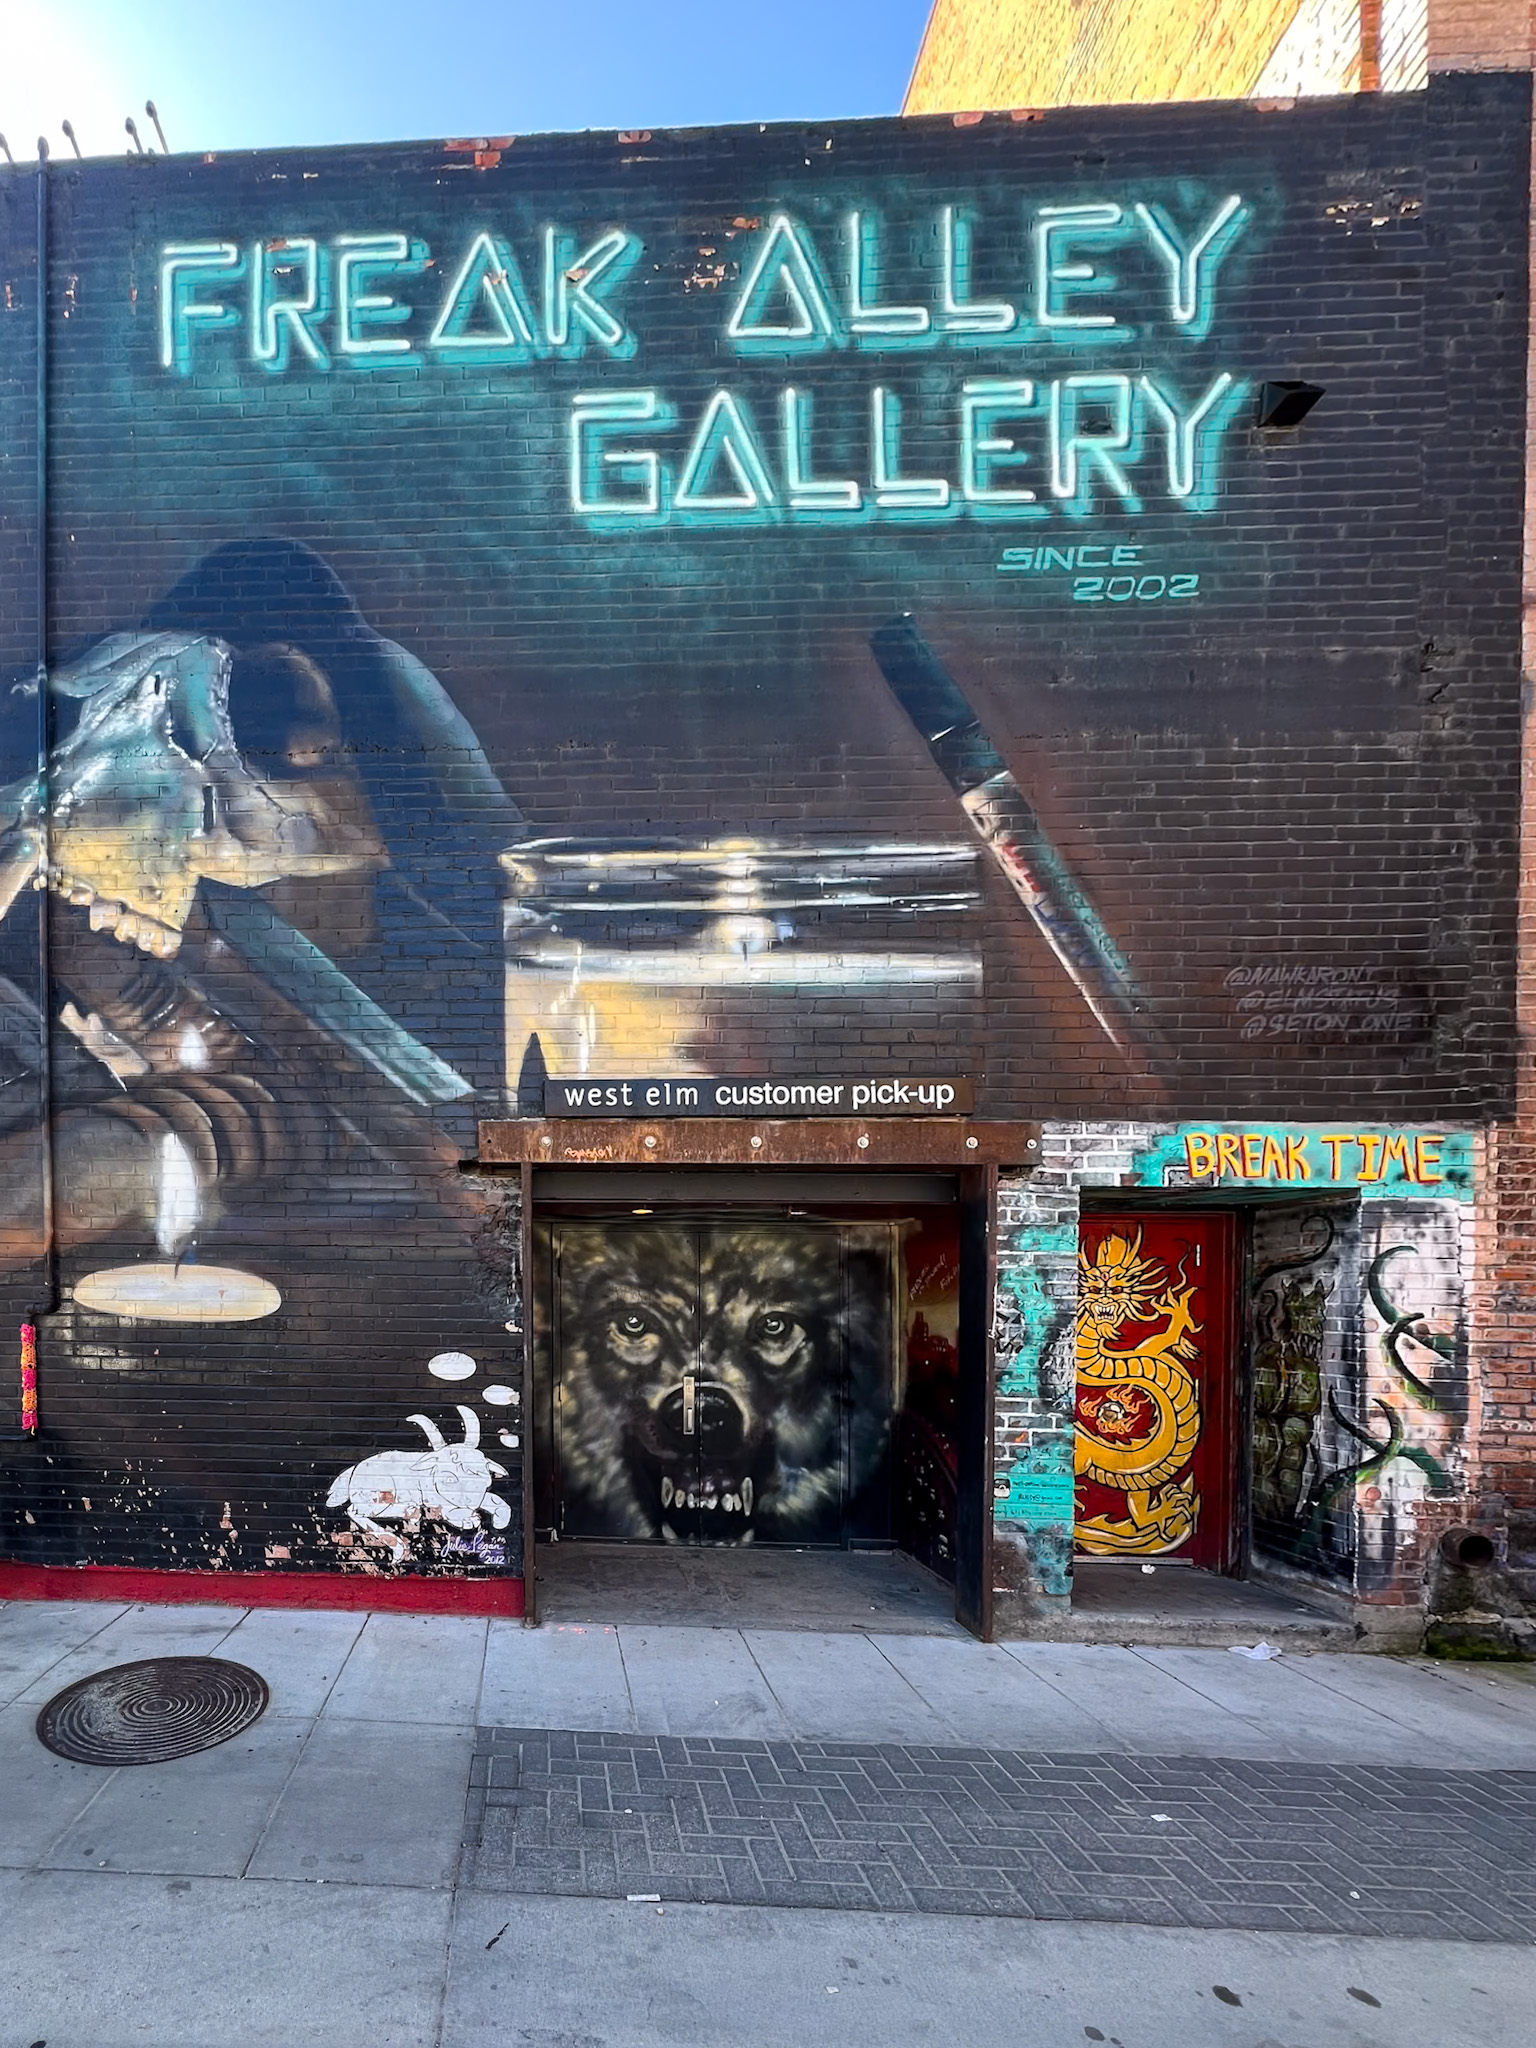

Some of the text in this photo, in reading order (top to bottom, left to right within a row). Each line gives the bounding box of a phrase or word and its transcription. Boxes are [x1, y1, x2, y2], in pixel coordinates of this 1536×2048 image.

[160, 194, 1250, 374] FREAK ALLEY
[570, 372, 1236, 530] GALLERY
[997, 545, 1144, 571] SINCE
[1073, 574, 1200, 601] 2002
[564, 1079, 955, 1111] west elm customer pick-up
[1185, 1133, 1445, 1184] BREAK TIME
[484, 1555, 505, 1565] 2012
